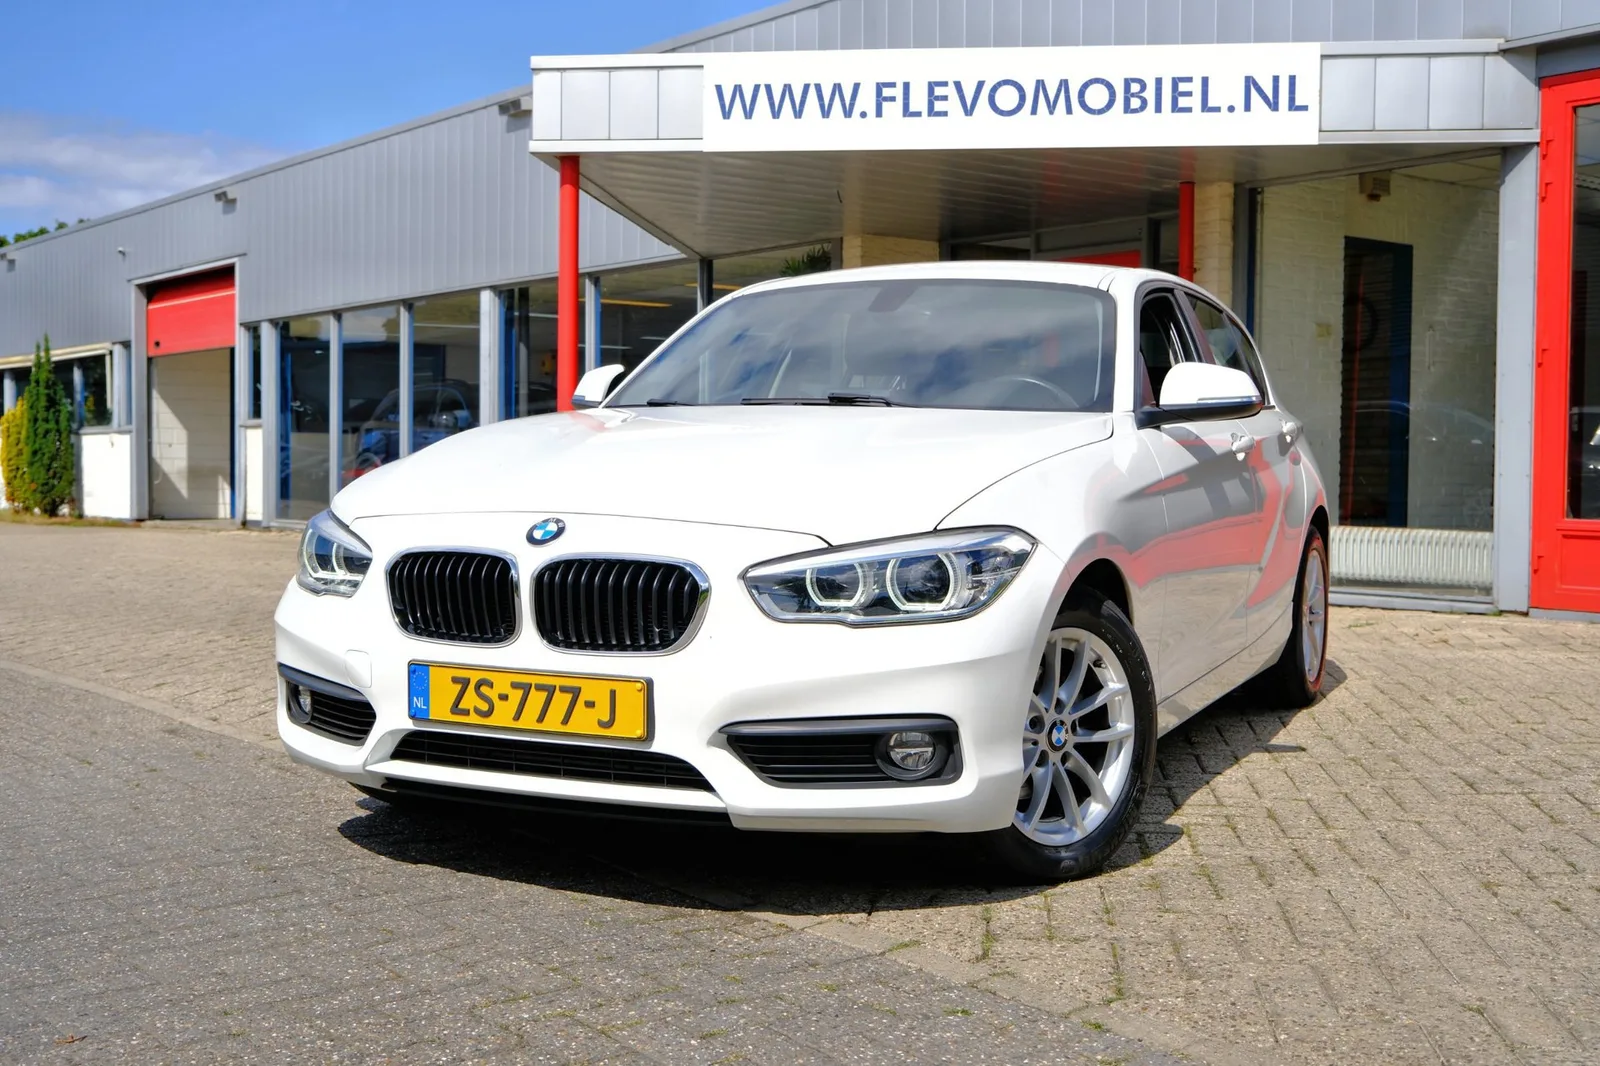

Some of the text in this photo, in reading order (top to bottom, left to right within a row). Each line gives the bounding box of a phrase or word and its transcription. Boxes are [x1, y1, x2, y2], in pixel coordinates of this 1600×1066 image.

[714, 74, 1309, 120] WWW.FLEVOMOBIEL.NL
[413, 696, 428, 709] NL
[450, 676, 617, 729] ZS-777-J
